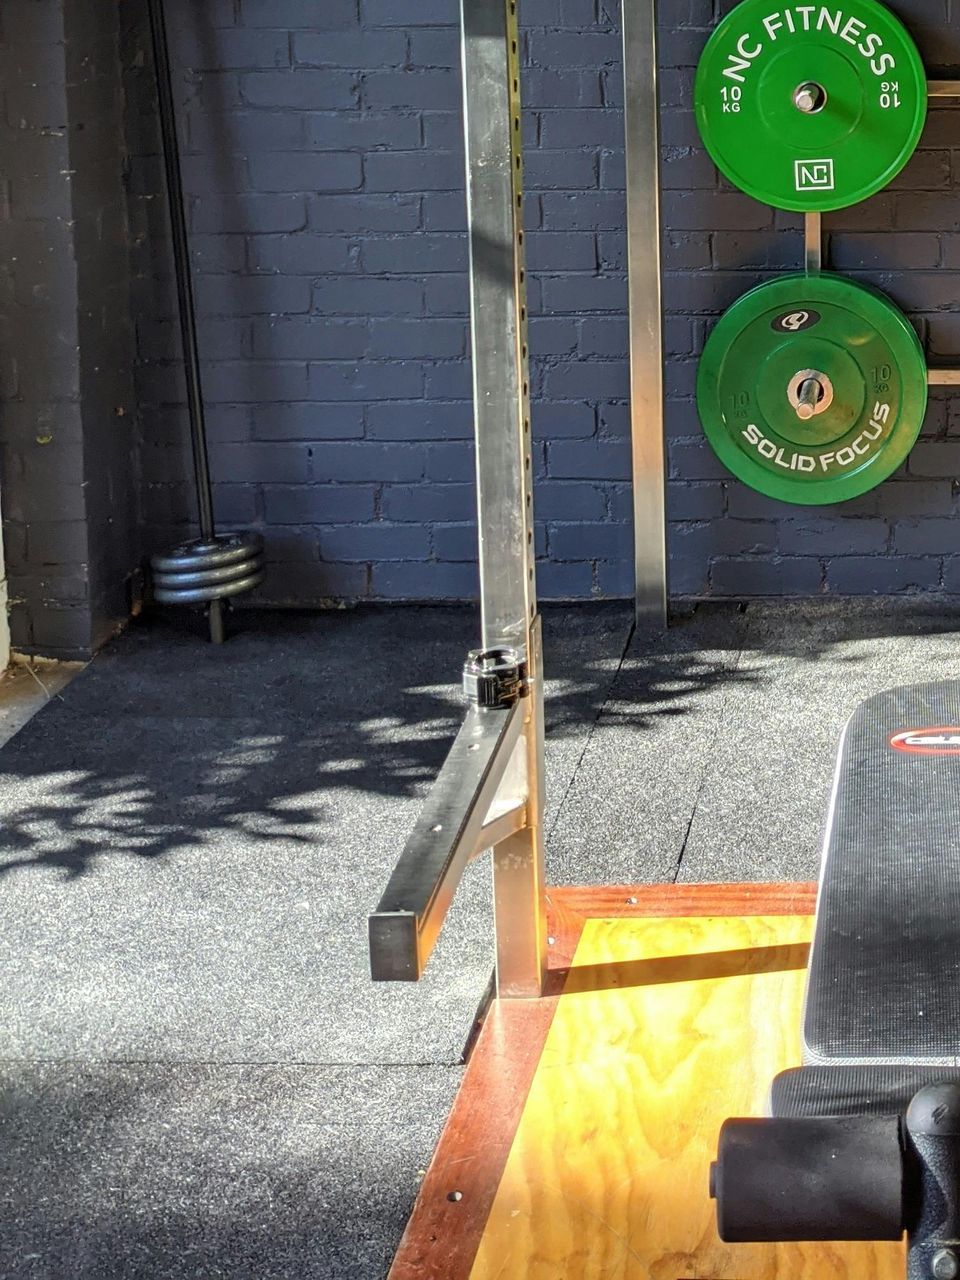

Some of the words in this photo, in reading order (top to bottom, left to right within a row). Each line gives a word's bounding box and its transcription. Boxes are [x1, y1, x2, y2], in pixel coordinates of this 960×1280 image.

[722, 33, 762, 82] NC
[762, 6, 895, 75] FITNESS
[720, 86, 741, 102] 10
[880, 82, 898, 92] KG
[723, 103, 740, 113] KG
[880, 94, 900, 108] 10
[741, 424, 815, 472] SOLID
[819, 401, 890, 472] FOCUS
